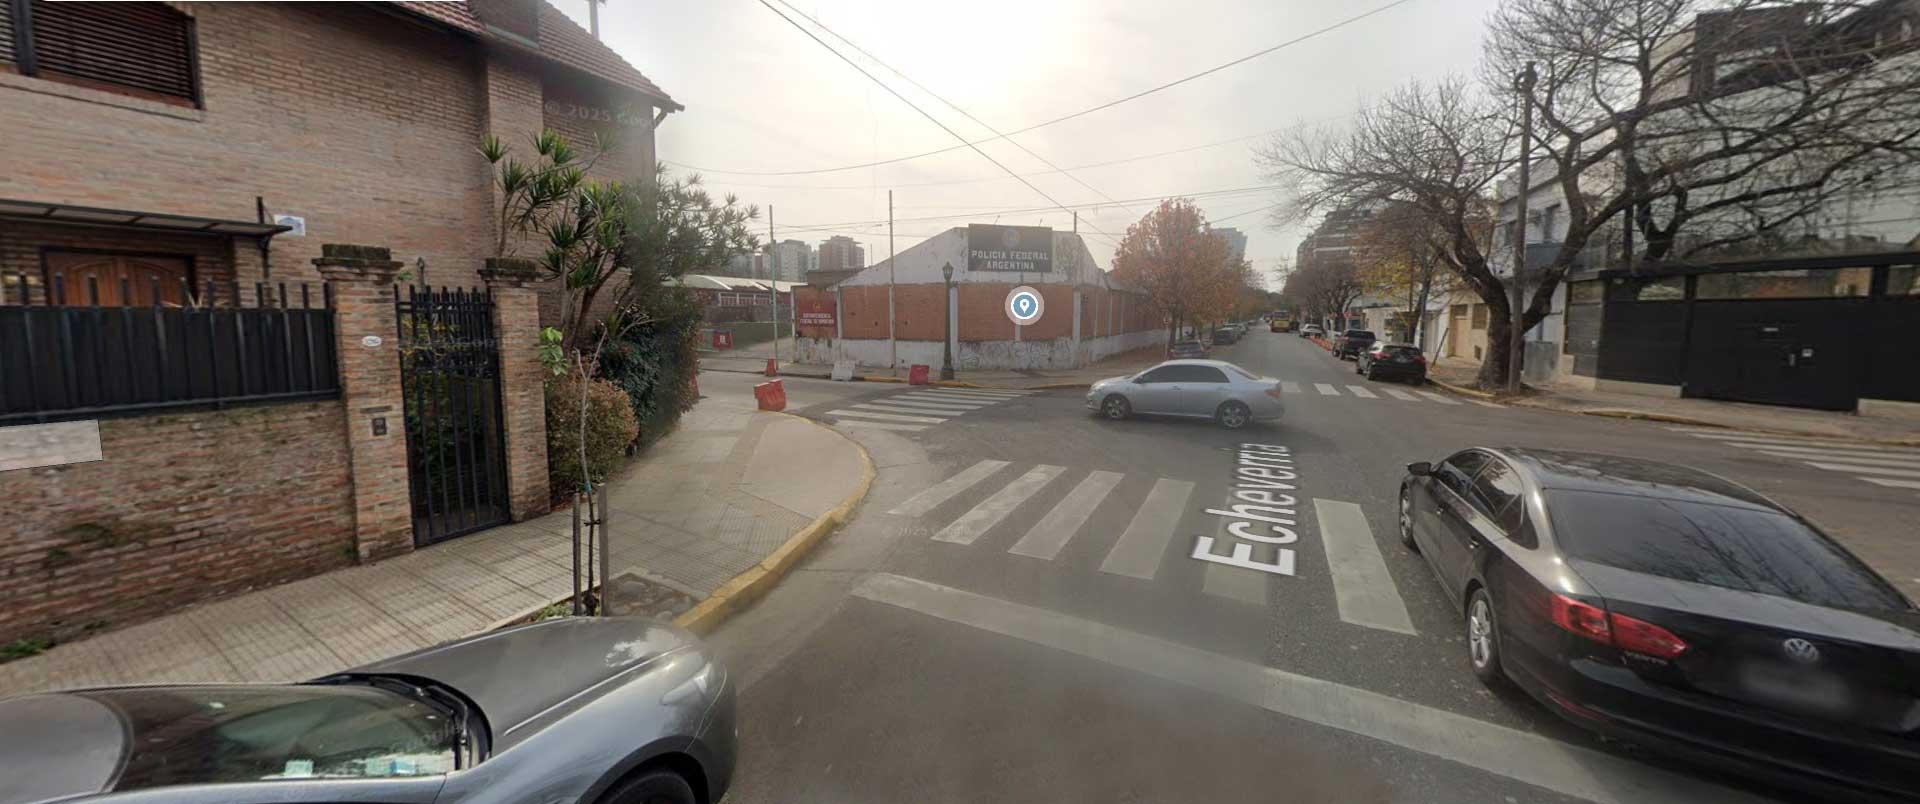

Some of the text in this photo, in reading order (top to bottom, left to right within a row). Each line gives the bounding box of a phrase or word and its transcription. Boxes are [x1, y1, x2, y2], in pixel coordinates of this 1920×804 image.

[971, 250, 1049, 261] POLICIA FEDERAL
[986, 261, 1035, 270] ARGENTINA
